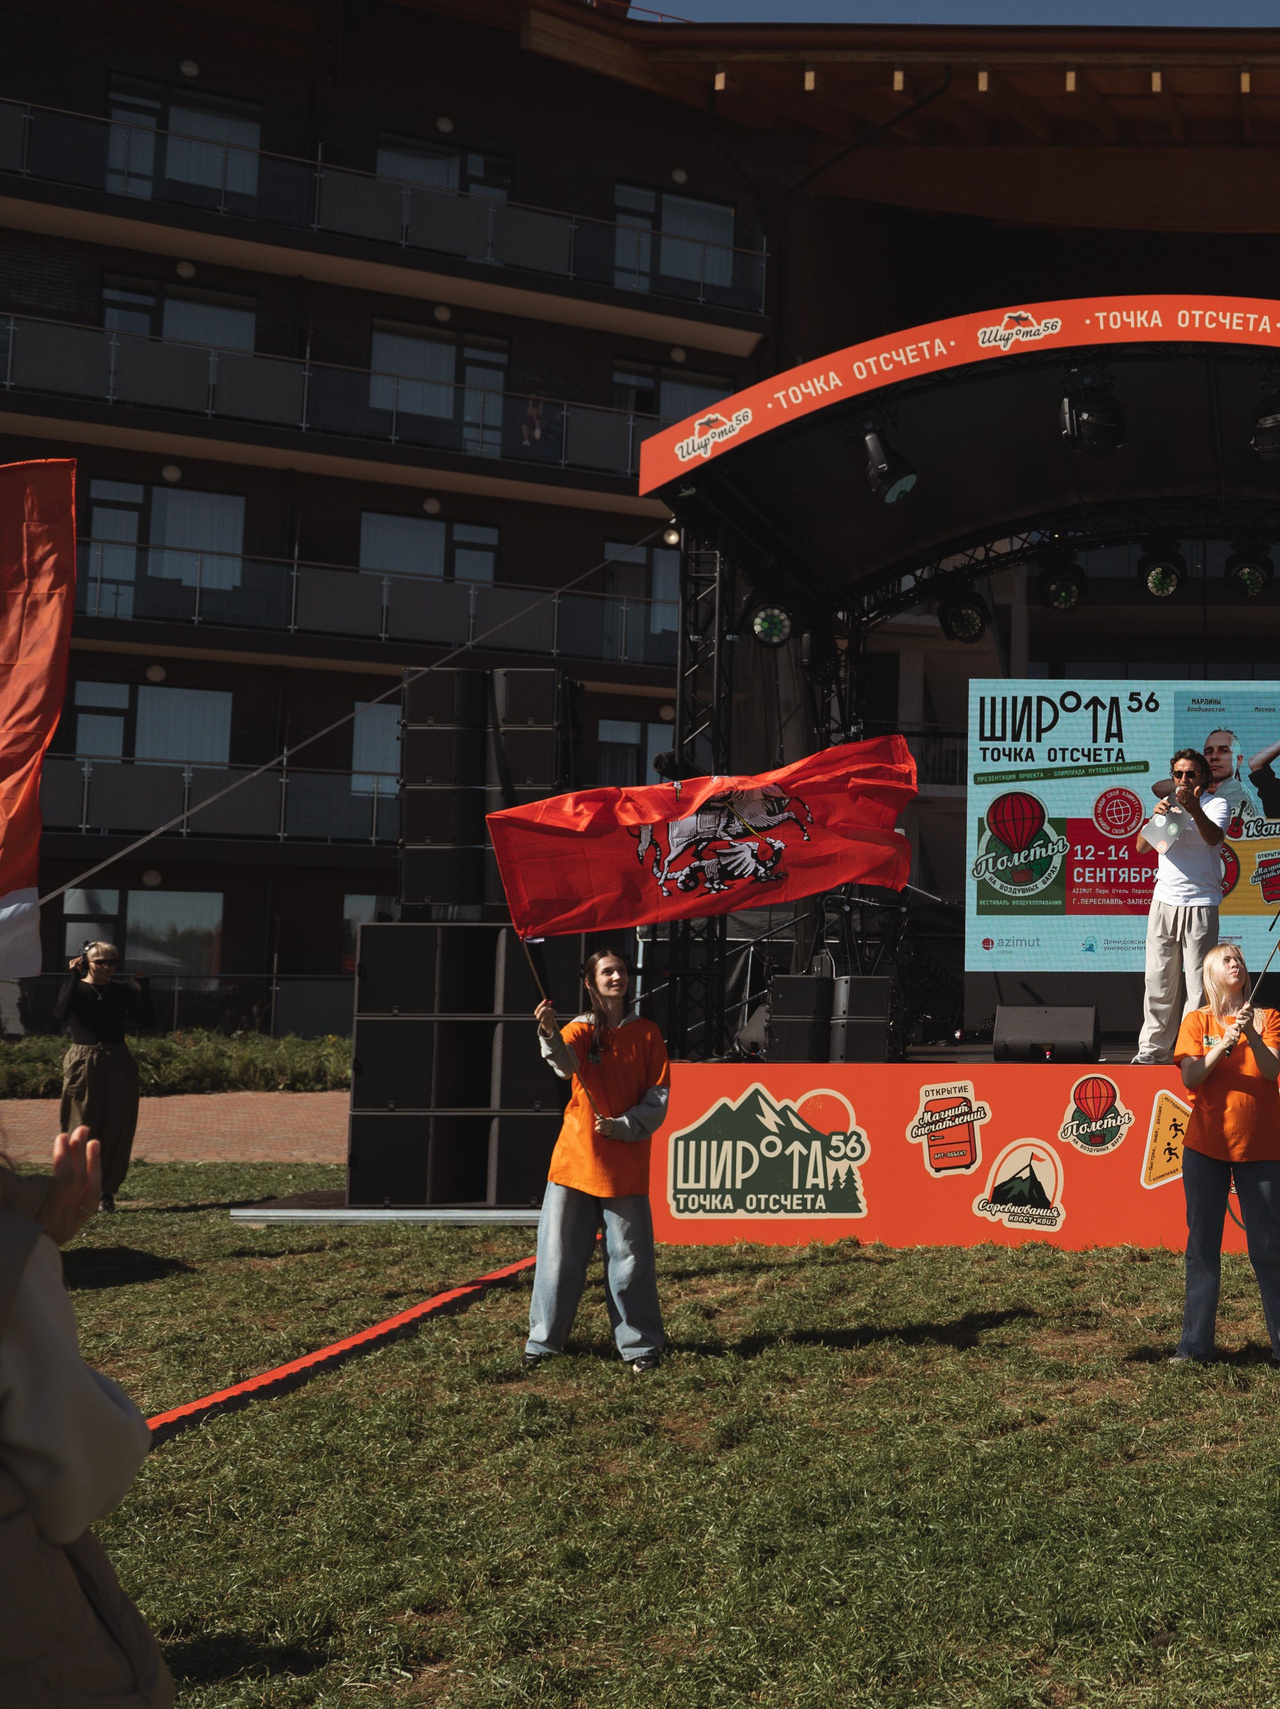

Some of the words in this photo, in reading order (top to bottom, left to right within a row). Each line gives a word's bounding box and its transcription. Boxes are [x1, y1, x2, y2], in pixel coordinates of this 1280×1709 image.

[1094, 310, 1163, 330] ТОЧКА
[1177, 310, 1272, 333] ОТСЧЕТА
[773, 371, 843, 409] ТОЧКА
[852, 338, 948, 380] ОТСЧЕТА
[979, 747, 1035, 762] ТОЧКА
[1047, 747, 1126, 763] ОТСЧЕТА
[976, 773, 1016, 782] ПРЕЗЕНТАЦИЯ
[1053, 769, 1085, 777] ОЛИМПИАДА
[1088, 764, 1145, 774] ПУТЕШЕСТВЕННИКОВ
[1106, 790, 1119, 798] СВОЙ
[973, 838, 1067, 877] Полеты
[1073, 845, 1129, 860] 12-14
[988, 876, 996, 886] НА
[999, 885, 1039, 895] ВОЗДУШНЫХ
[1041, 865, 1058, 885] ШАРАХ
[997, 936, 1041, 947] azimut
[924, 1085, 969, 1097] ОТКРЫТИЕ
[911, 1107, 986, 1138] впечатлений
[919, 1102, 970, 1125] Магнит
[1061, 1112, 1131, 1138] Полеты
[1072, 1137, 1079, 1145] НА
[677, 1194, 734, 1210] ТОЧКА
[746, 1194, 826, 1210] ОТСЧЕТА
[978, 1199, 1060, 1217] Соревнования
